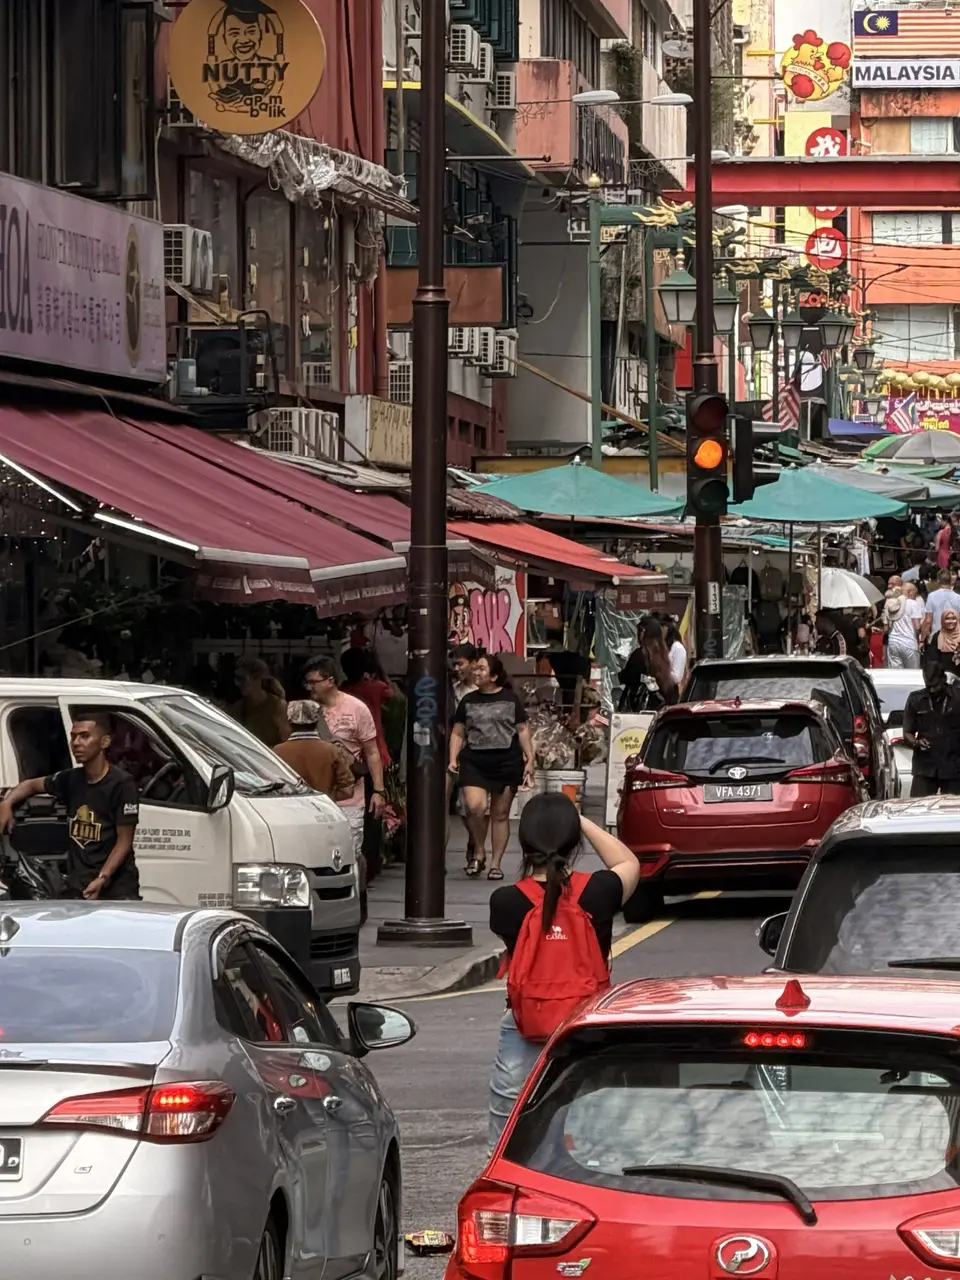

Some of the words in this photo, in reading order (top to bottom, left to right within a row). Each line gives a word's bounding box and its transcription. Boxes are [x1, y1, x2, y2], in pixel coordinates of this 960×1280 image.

[203, 62, 290, 83] NUTTY
[855, 64, 955, 82] MALAYSIA
[715, 785, 734, 798] VFA
[736, 785, 762, 797] 4371
[546, 933, 568, 941] CAMEL
